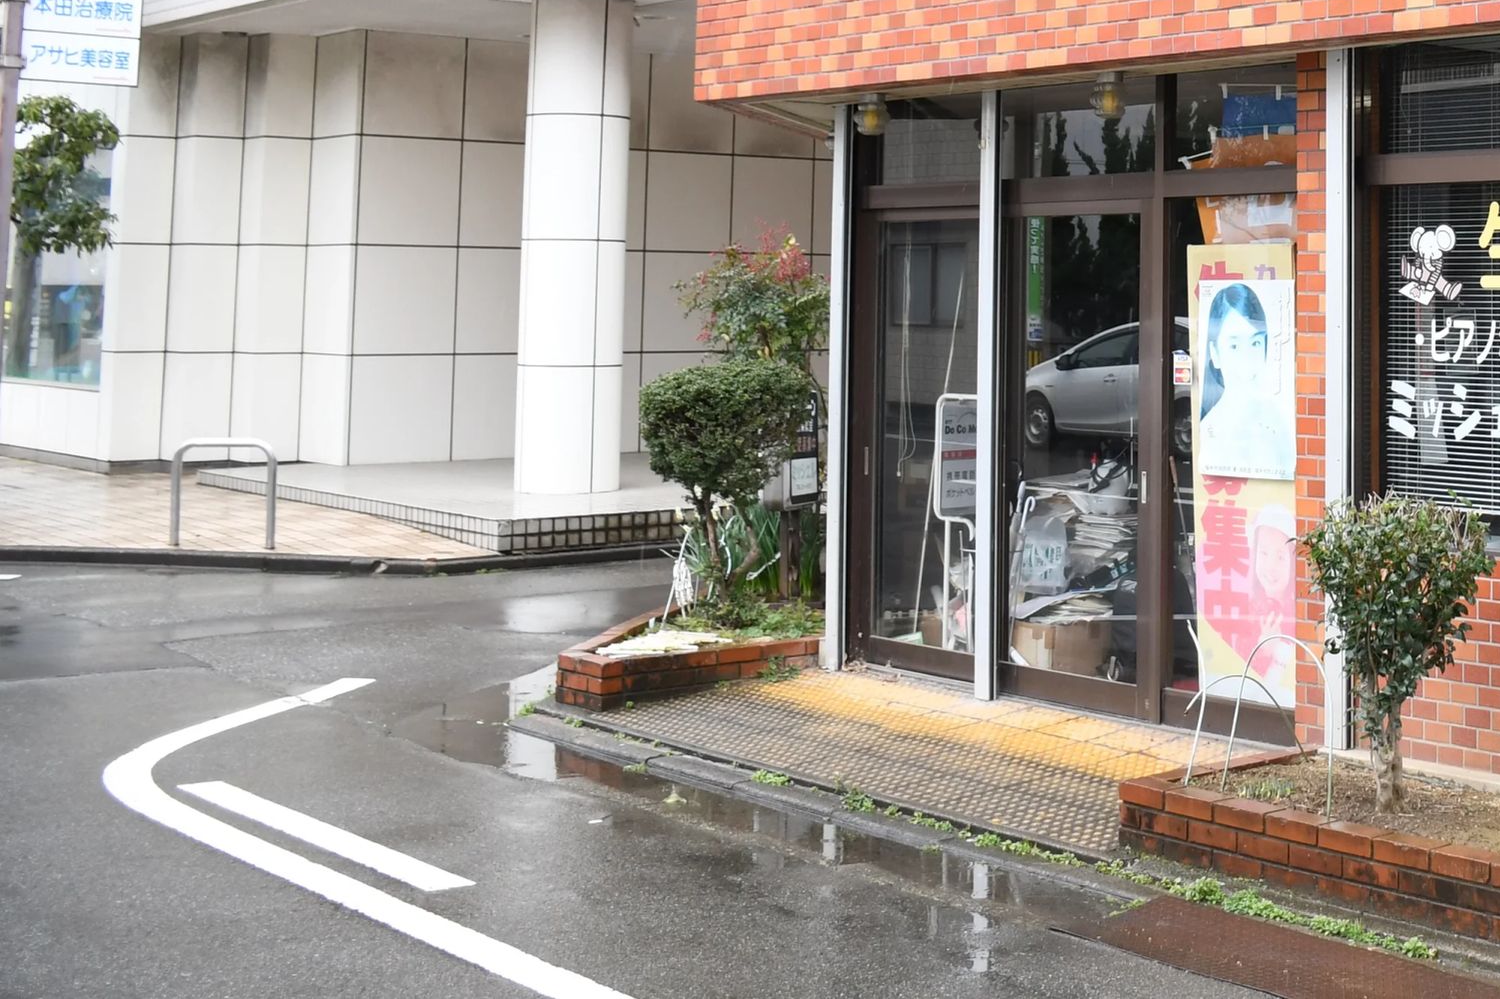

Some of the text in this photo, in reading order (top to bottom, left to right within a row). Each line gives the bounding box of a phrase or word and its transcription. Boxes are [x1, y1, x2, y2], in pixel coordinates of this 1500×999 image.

[30, 44, 130, 70] アサヒ美容室
